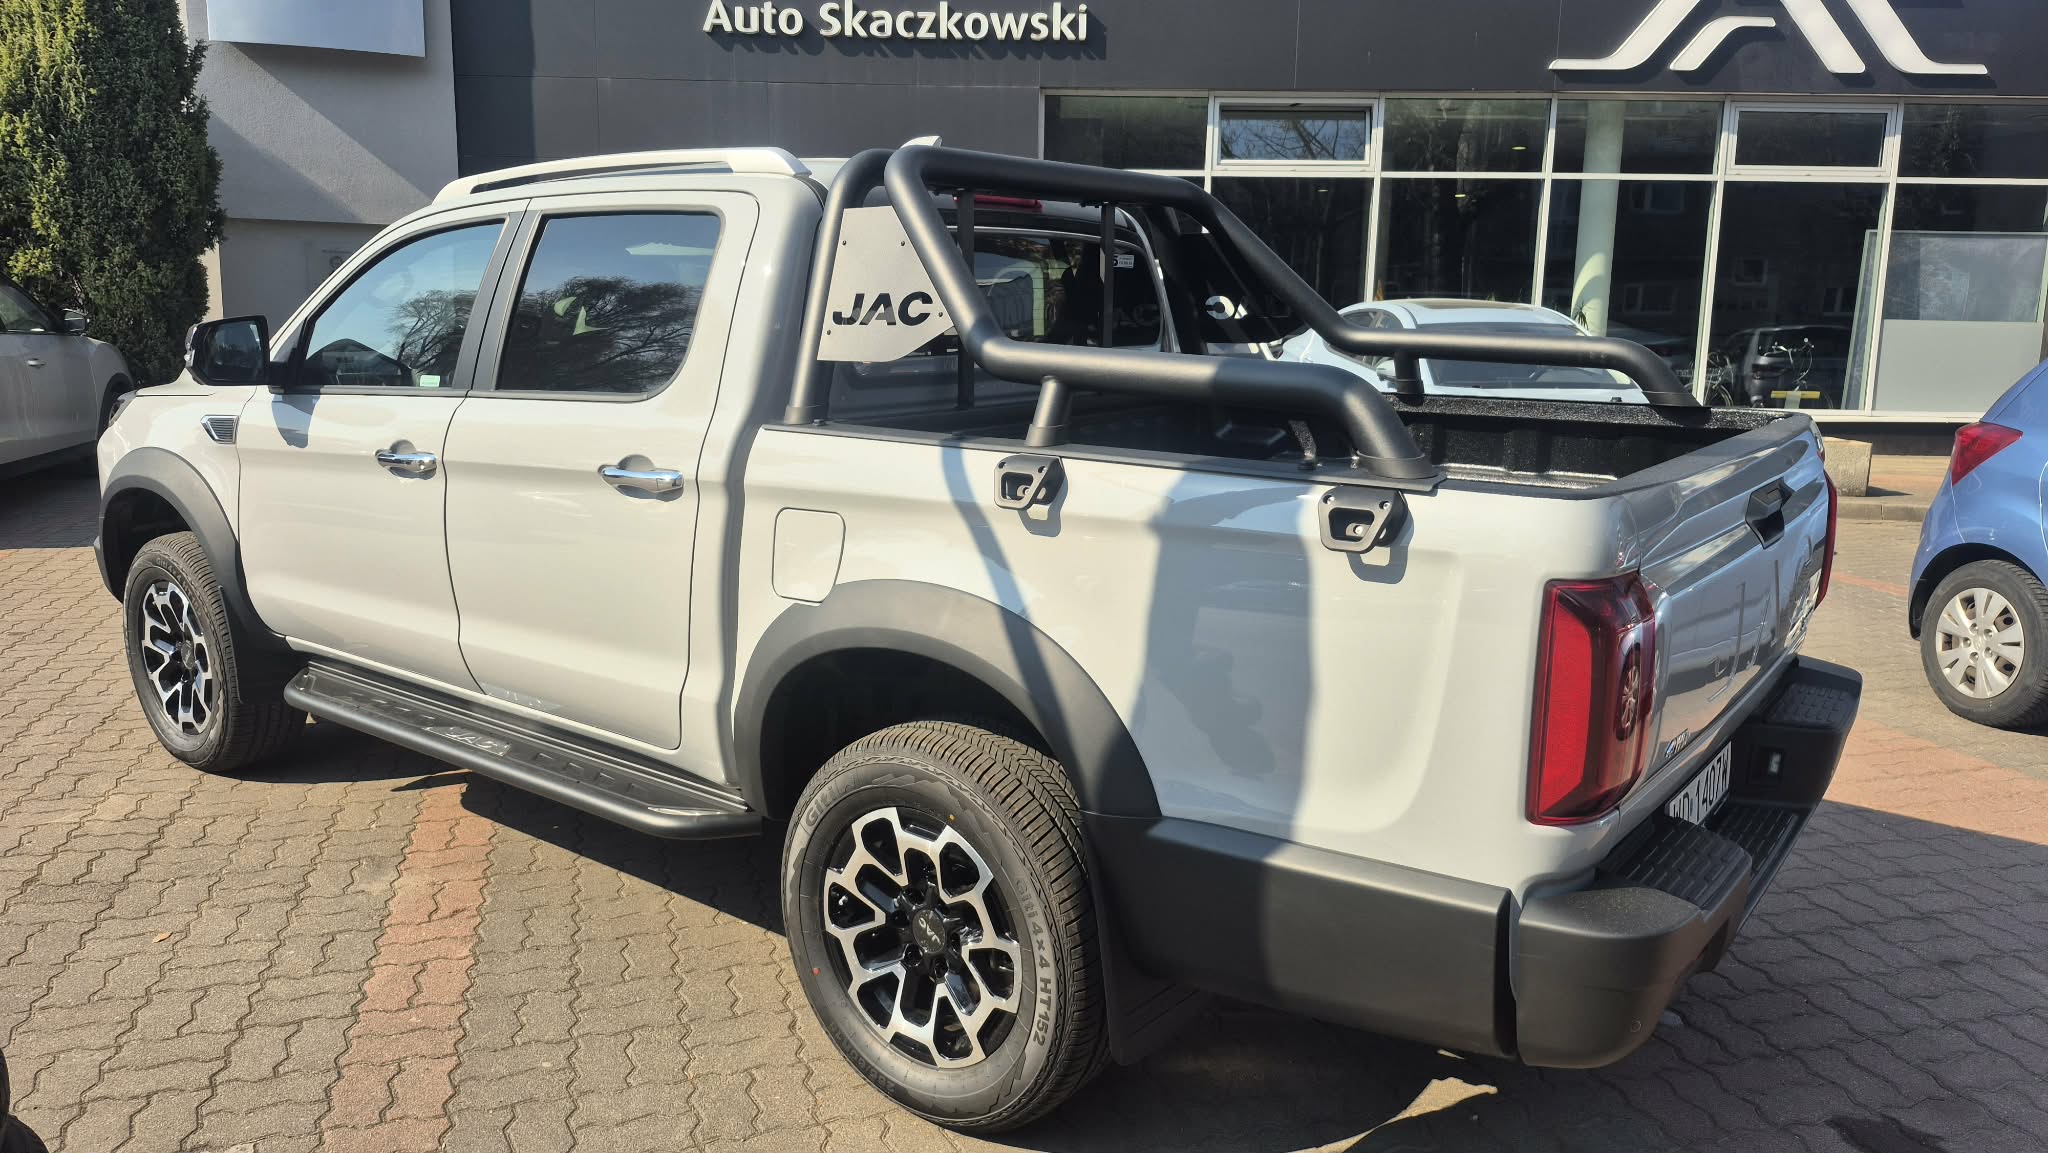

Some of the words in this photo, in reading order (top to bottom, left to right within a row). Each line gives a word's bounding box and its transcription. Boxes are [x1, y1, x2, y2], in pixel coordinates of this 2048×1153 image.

[702, 0, 804, 36] Auto
[819, 1, 1089, 41] Skaczkowski
[832, 291, 933, 326] JAC
[1016, 879, 1039, 919] Giti
[1032, 977, 1052, 1047] HT152
